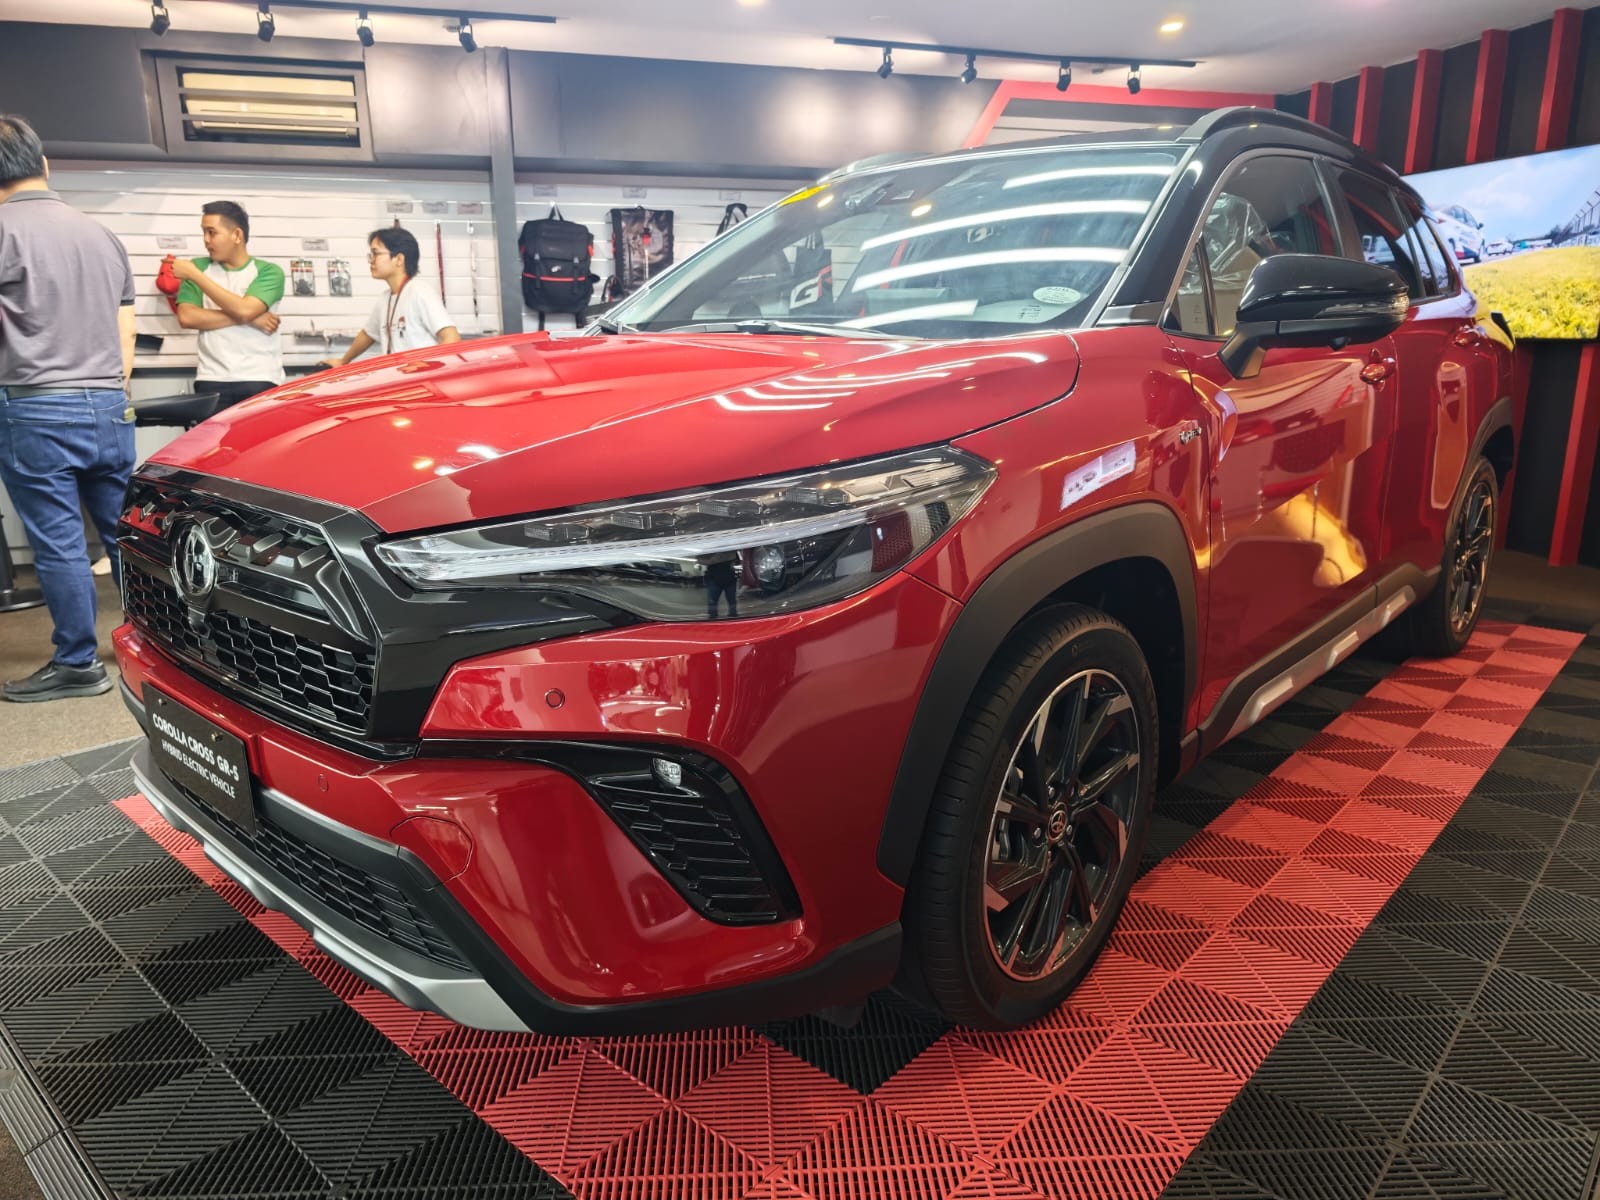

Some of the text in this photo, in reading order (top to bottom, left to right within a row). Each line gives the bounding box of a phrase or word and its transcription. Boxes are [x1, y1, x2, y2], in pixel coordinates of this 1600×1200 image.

[153, 713, 239, 781] COROLLA CROSS GR-S
[161, 739, 235, 798] HYBRID ELECTRIC VEHICLE
